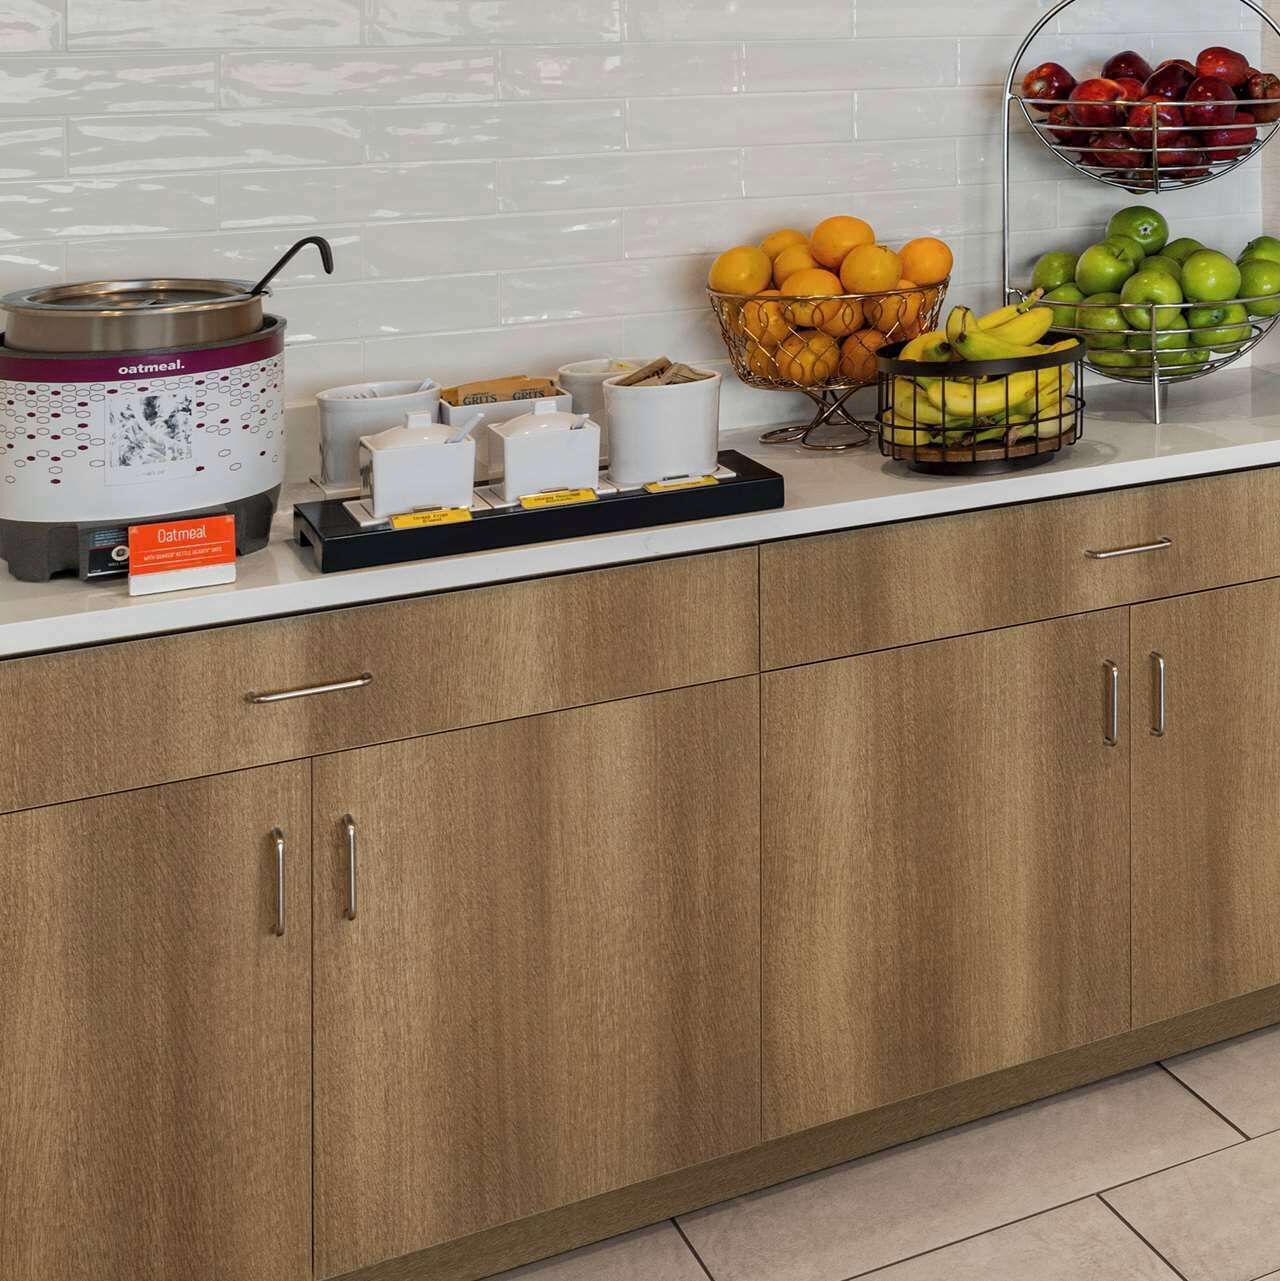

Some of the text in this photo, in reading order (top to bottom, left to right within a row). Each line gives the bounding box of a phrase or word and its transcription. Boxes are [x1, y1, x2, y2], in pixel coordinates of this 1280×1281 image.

[118, 360, 185, 375] oatmeal.
[463, 395, 497, 405] GRITS
[513, 391, 545, 400] GRITS
[157, 525, 208, 543] Oatmeal
